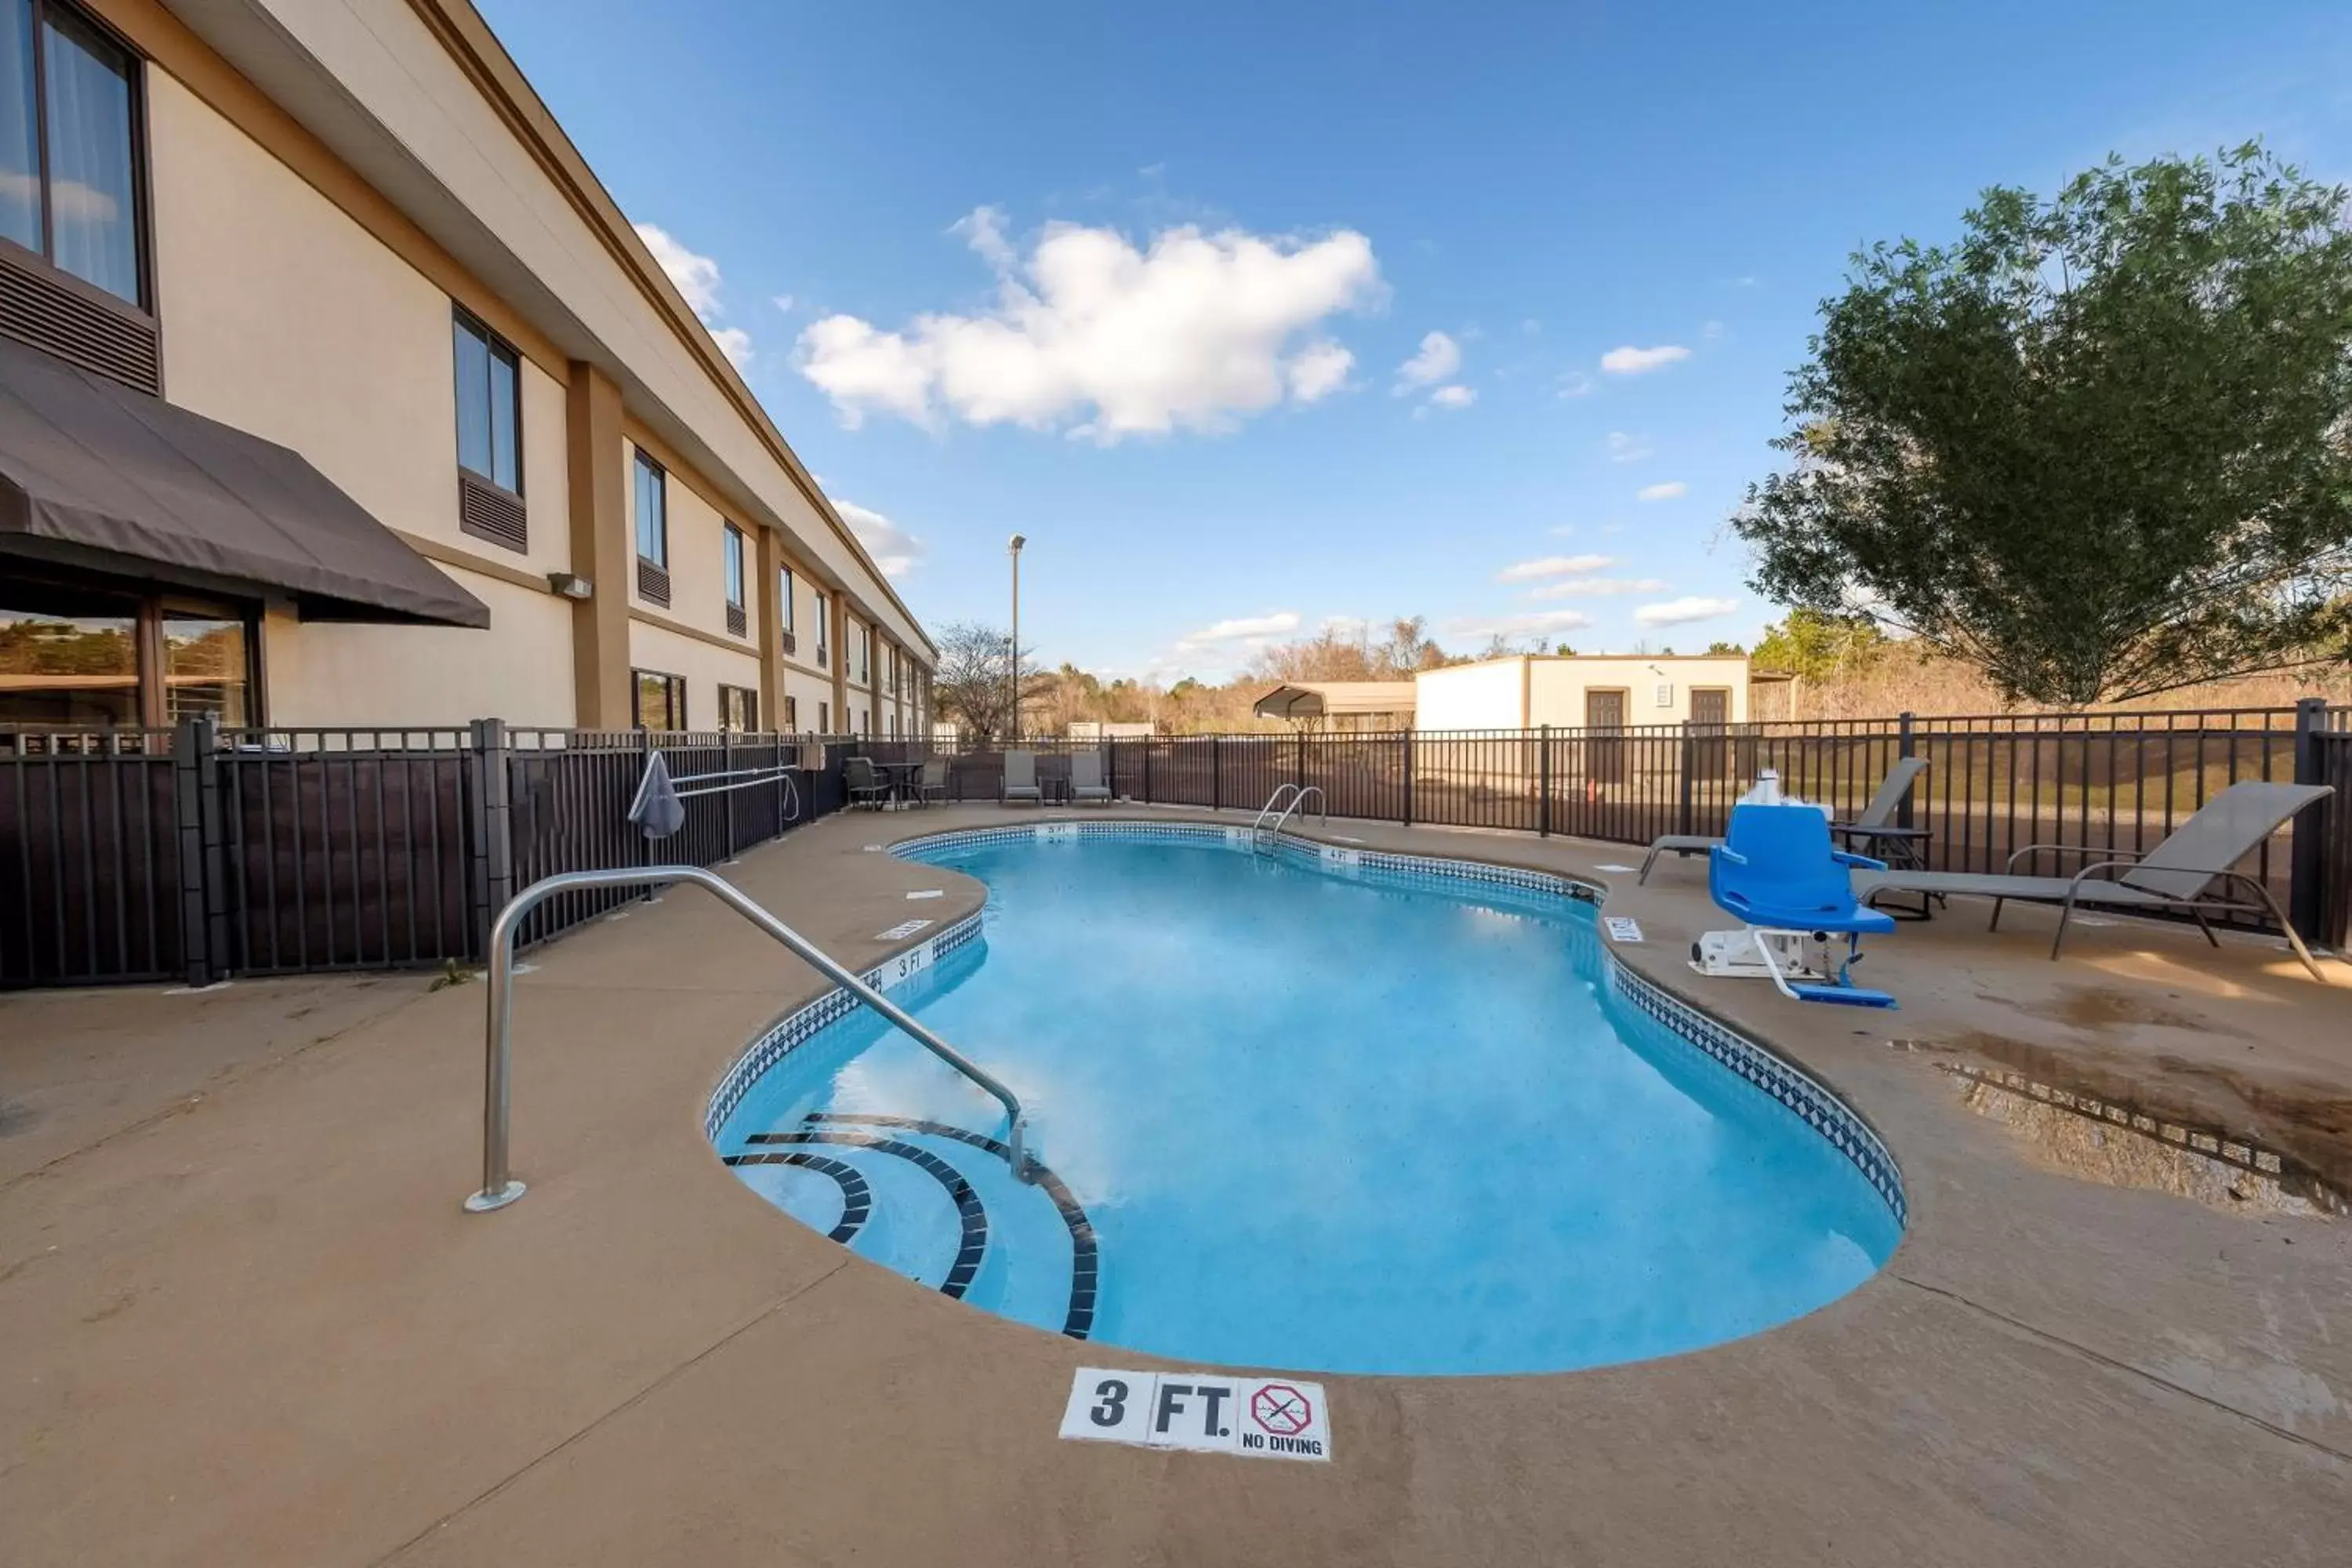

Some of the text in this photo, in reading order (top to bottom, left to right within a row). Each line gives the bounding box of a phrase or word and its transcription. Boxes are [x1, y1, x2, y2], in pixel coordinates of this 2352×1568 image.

[899, 949, 920, 978] 3 FT
[1091, 1379, 1231, 1437] 3 FT.
[1243, 1432, 1323, 1456] NO DIVING
